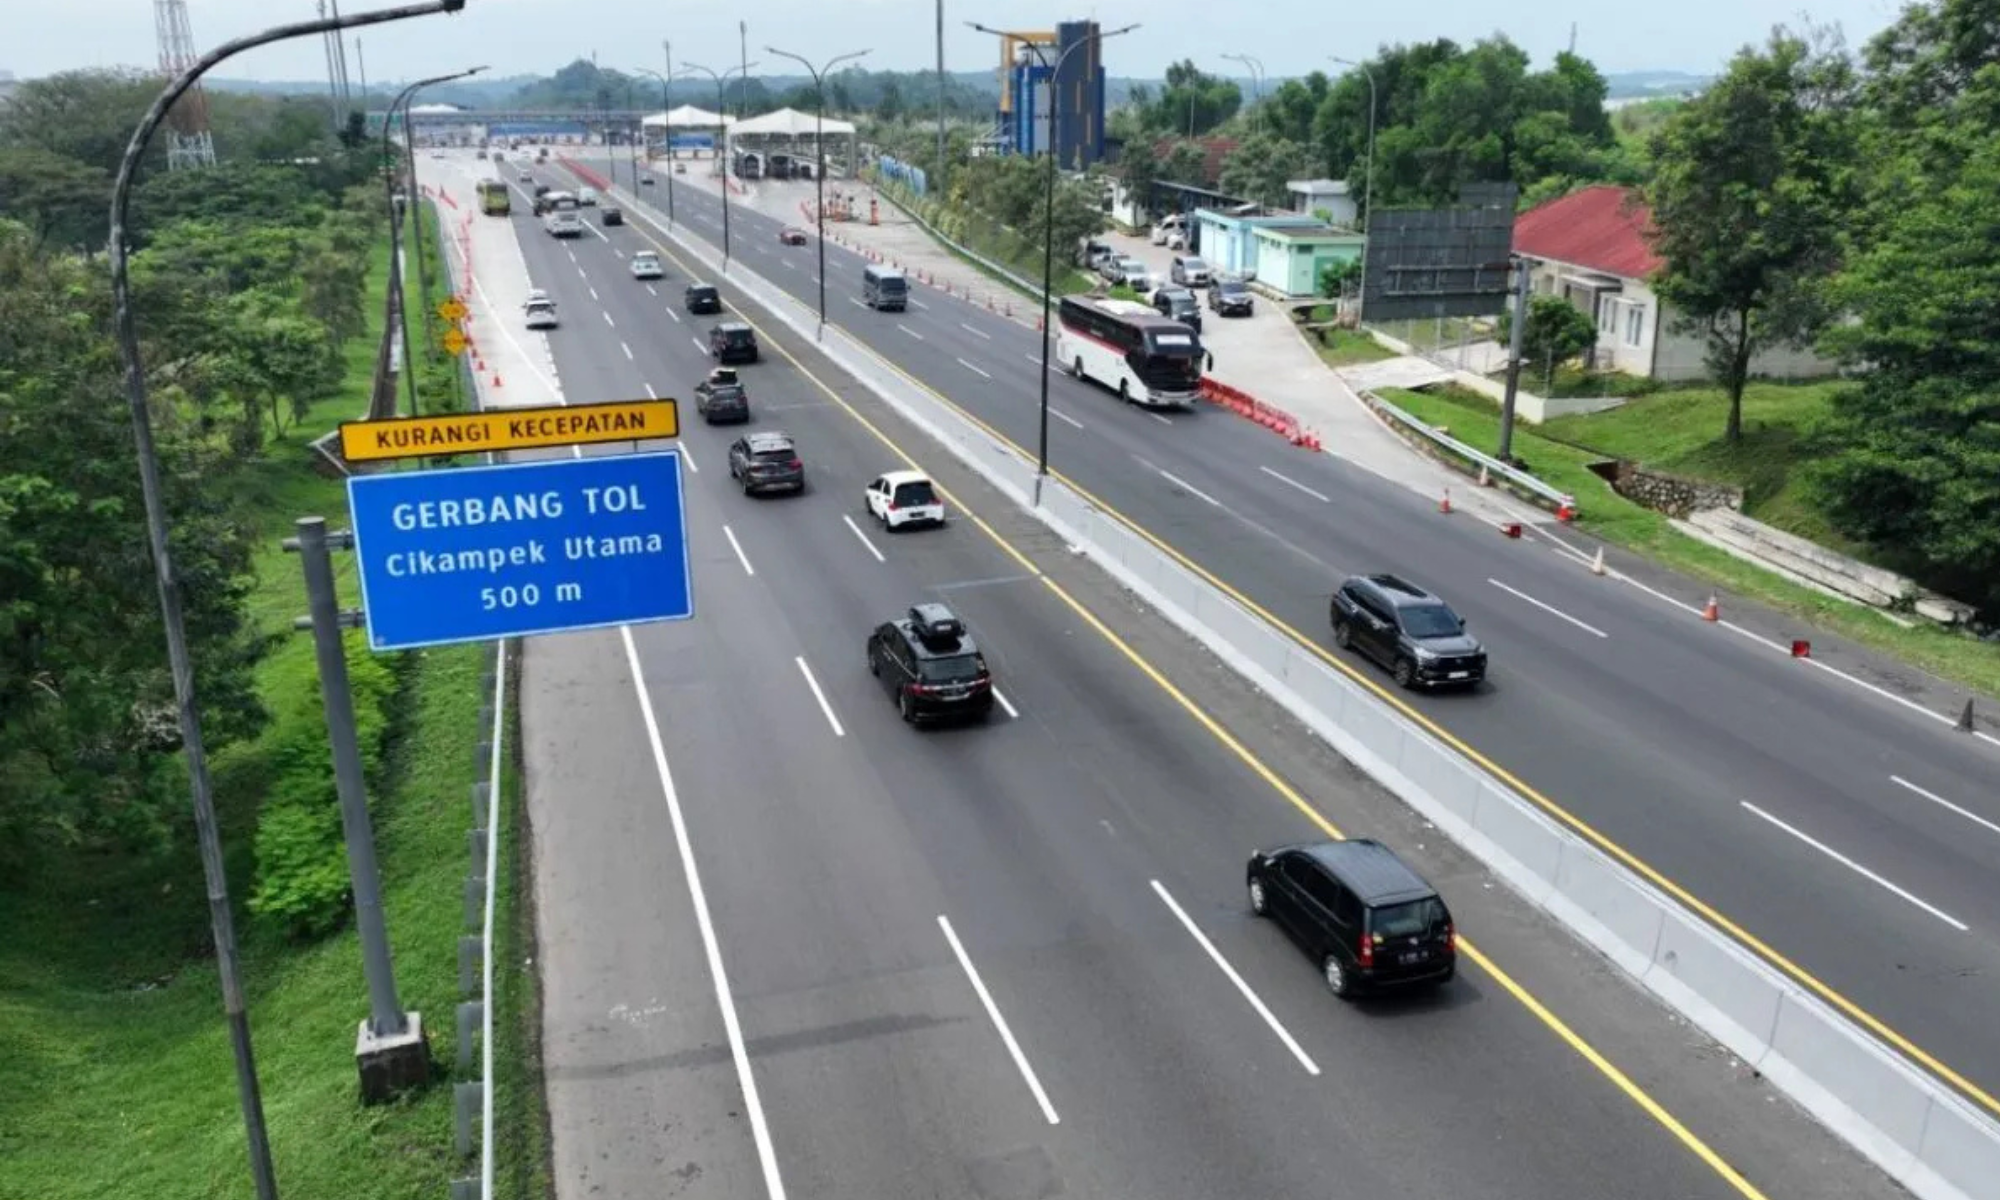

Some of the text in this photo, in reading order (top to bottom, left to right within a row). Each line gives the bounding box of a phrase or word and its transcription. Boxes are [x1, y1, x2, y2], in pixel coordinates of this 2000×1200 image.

[376, 411, 646, 448] KURANGI KECEPATAN
[392, 484, 646, 530] GERBANG TOL
[386, 533, 662, 576] Cikampek Utama
[481, 582, 581, 610] 500 m
